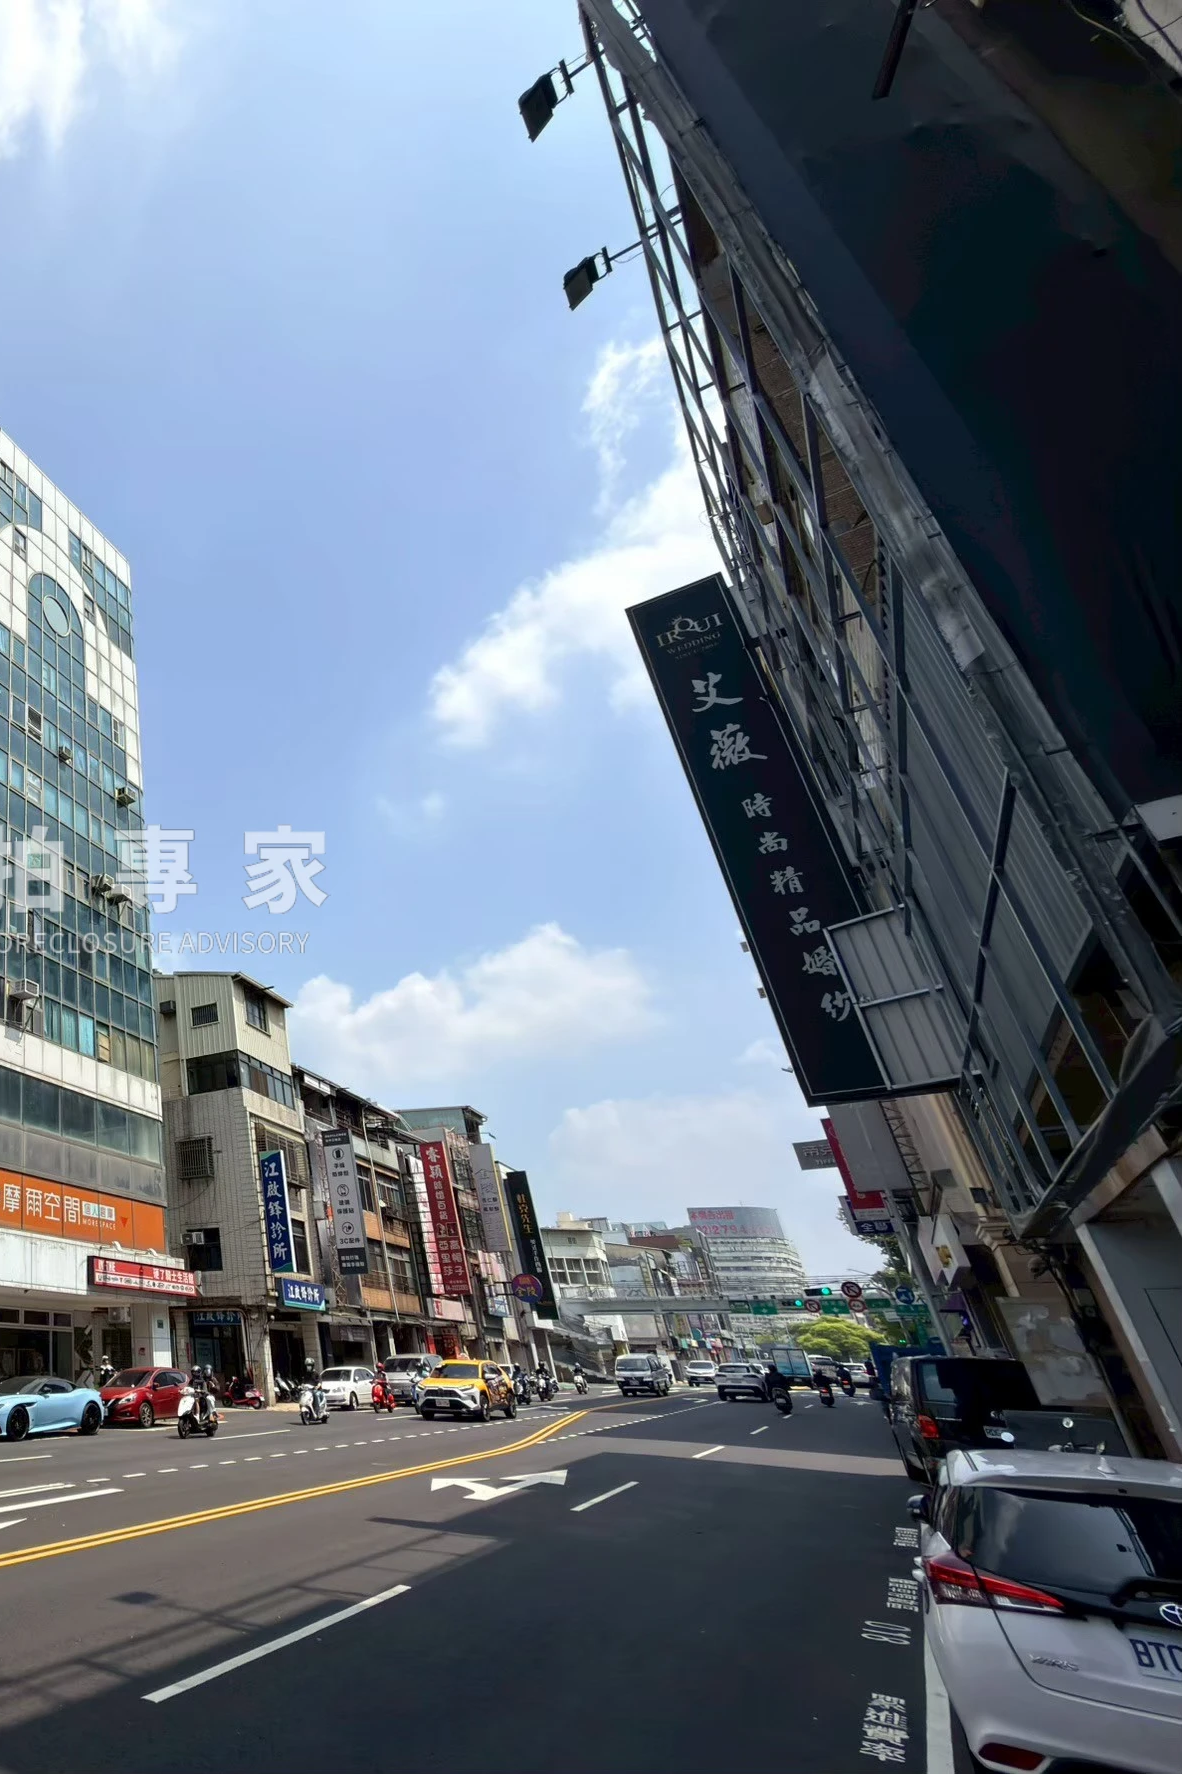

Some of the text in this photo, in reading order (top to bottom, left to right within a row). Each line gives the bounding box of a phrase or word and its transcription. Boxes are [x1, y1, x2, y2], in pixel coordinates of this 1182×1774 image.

[667, 632, 721, 654] WEDDING
[3, 1184, 80, 1225] 摩爾空間
